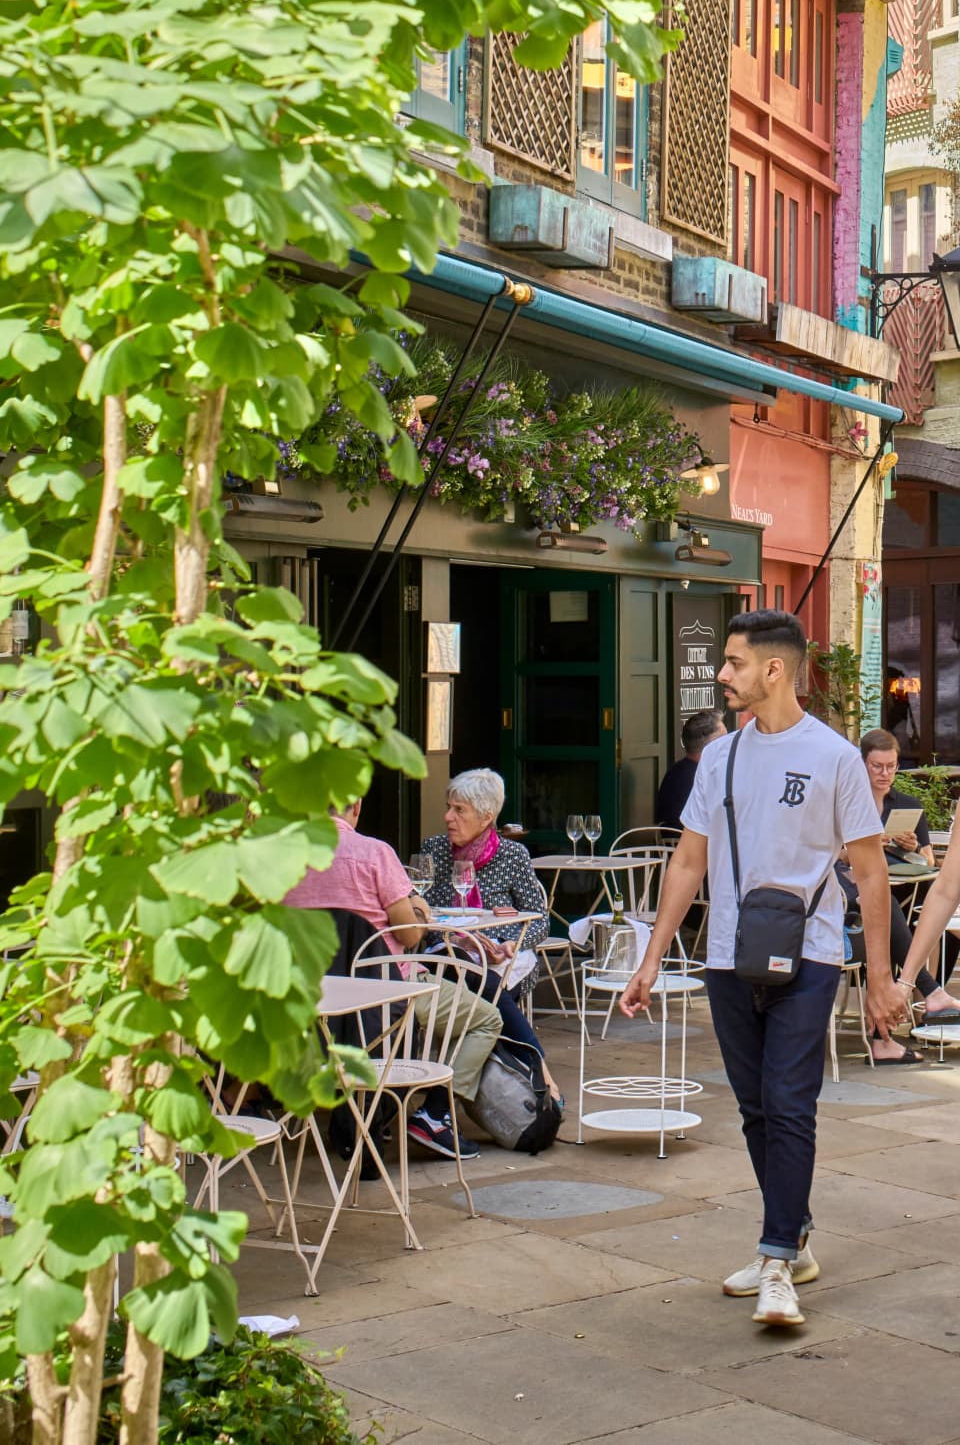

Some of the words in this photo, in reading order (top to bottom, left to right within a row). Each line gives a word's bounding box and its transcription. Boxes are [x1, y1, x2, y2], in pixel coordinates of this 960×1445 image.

[755, 508, 773, 526] YARD
[680, 666, 695, 680] DES
[697, 665, 715, 679] VINS
